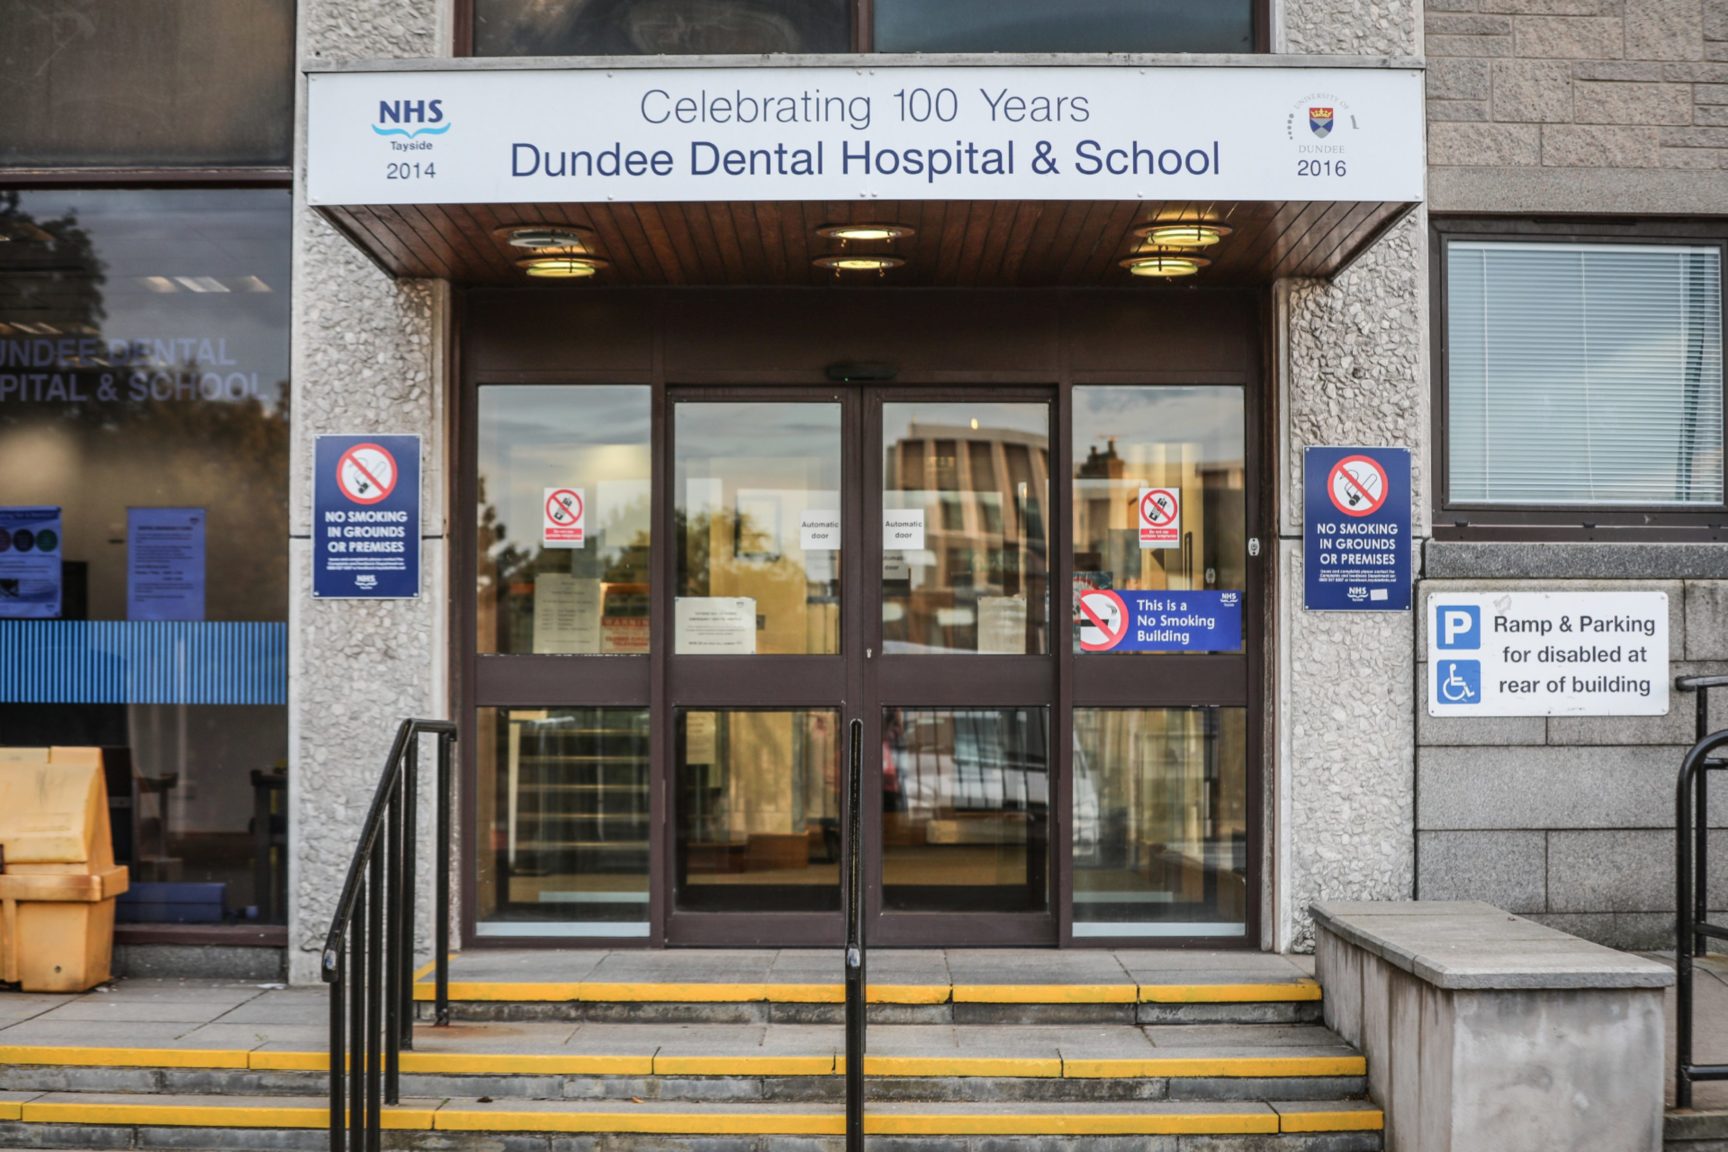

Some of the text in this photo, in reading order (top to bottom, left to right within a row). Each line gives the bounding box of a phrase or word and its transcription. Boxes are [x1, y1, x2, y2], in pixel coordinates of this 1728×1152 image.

[379, 99, 443, 123] NHS
[640, 88, 1090, 131] Celebrating 100 Years
[390, 140, 433, 151] Tayside
[1298, 145, 1345, 154] DUNDEE
[511, 139, 1219, 184] Dundee Dental Hospital & School
[1297, 159, 1347, 177] 2016
[386, 162, 437, 180] 2014
[108, 338, 237, 367] DENTAL
[97, 373, 119, 401] &
[128, 372, 269, 401] SCHOOL
[325, 511, 408, 523] NO SMOKING
[801, 520, 840, 528] Automatic
[885, 520, 923, 528] Automatic
[327, 526, 405, 538] IN GROUNDS
[1317, 523, 1398, 535] NO SMOKING
[327, 542, 405, 553] OR PREMISES
[1319, 538, 1396, 550] IN GROUNDS
[1319, 554, 1396, 566] OR PREMISES
[1221, 592, 1237, 600] NHS
[1348, 586, 1367, 594] NHS
[1136, 599, 1188, 612] This is a
[1137, 614, 1215, 630] No Smoking
[1444, 610, 1473, 645] P
[1494, 615, 1655, 637] Ramp & Parking
[1137, 630, 1190, 645] Building
[1502, 646, 1648, 663] for disabled at
[1499, 676, 1651, 697] rear of building
